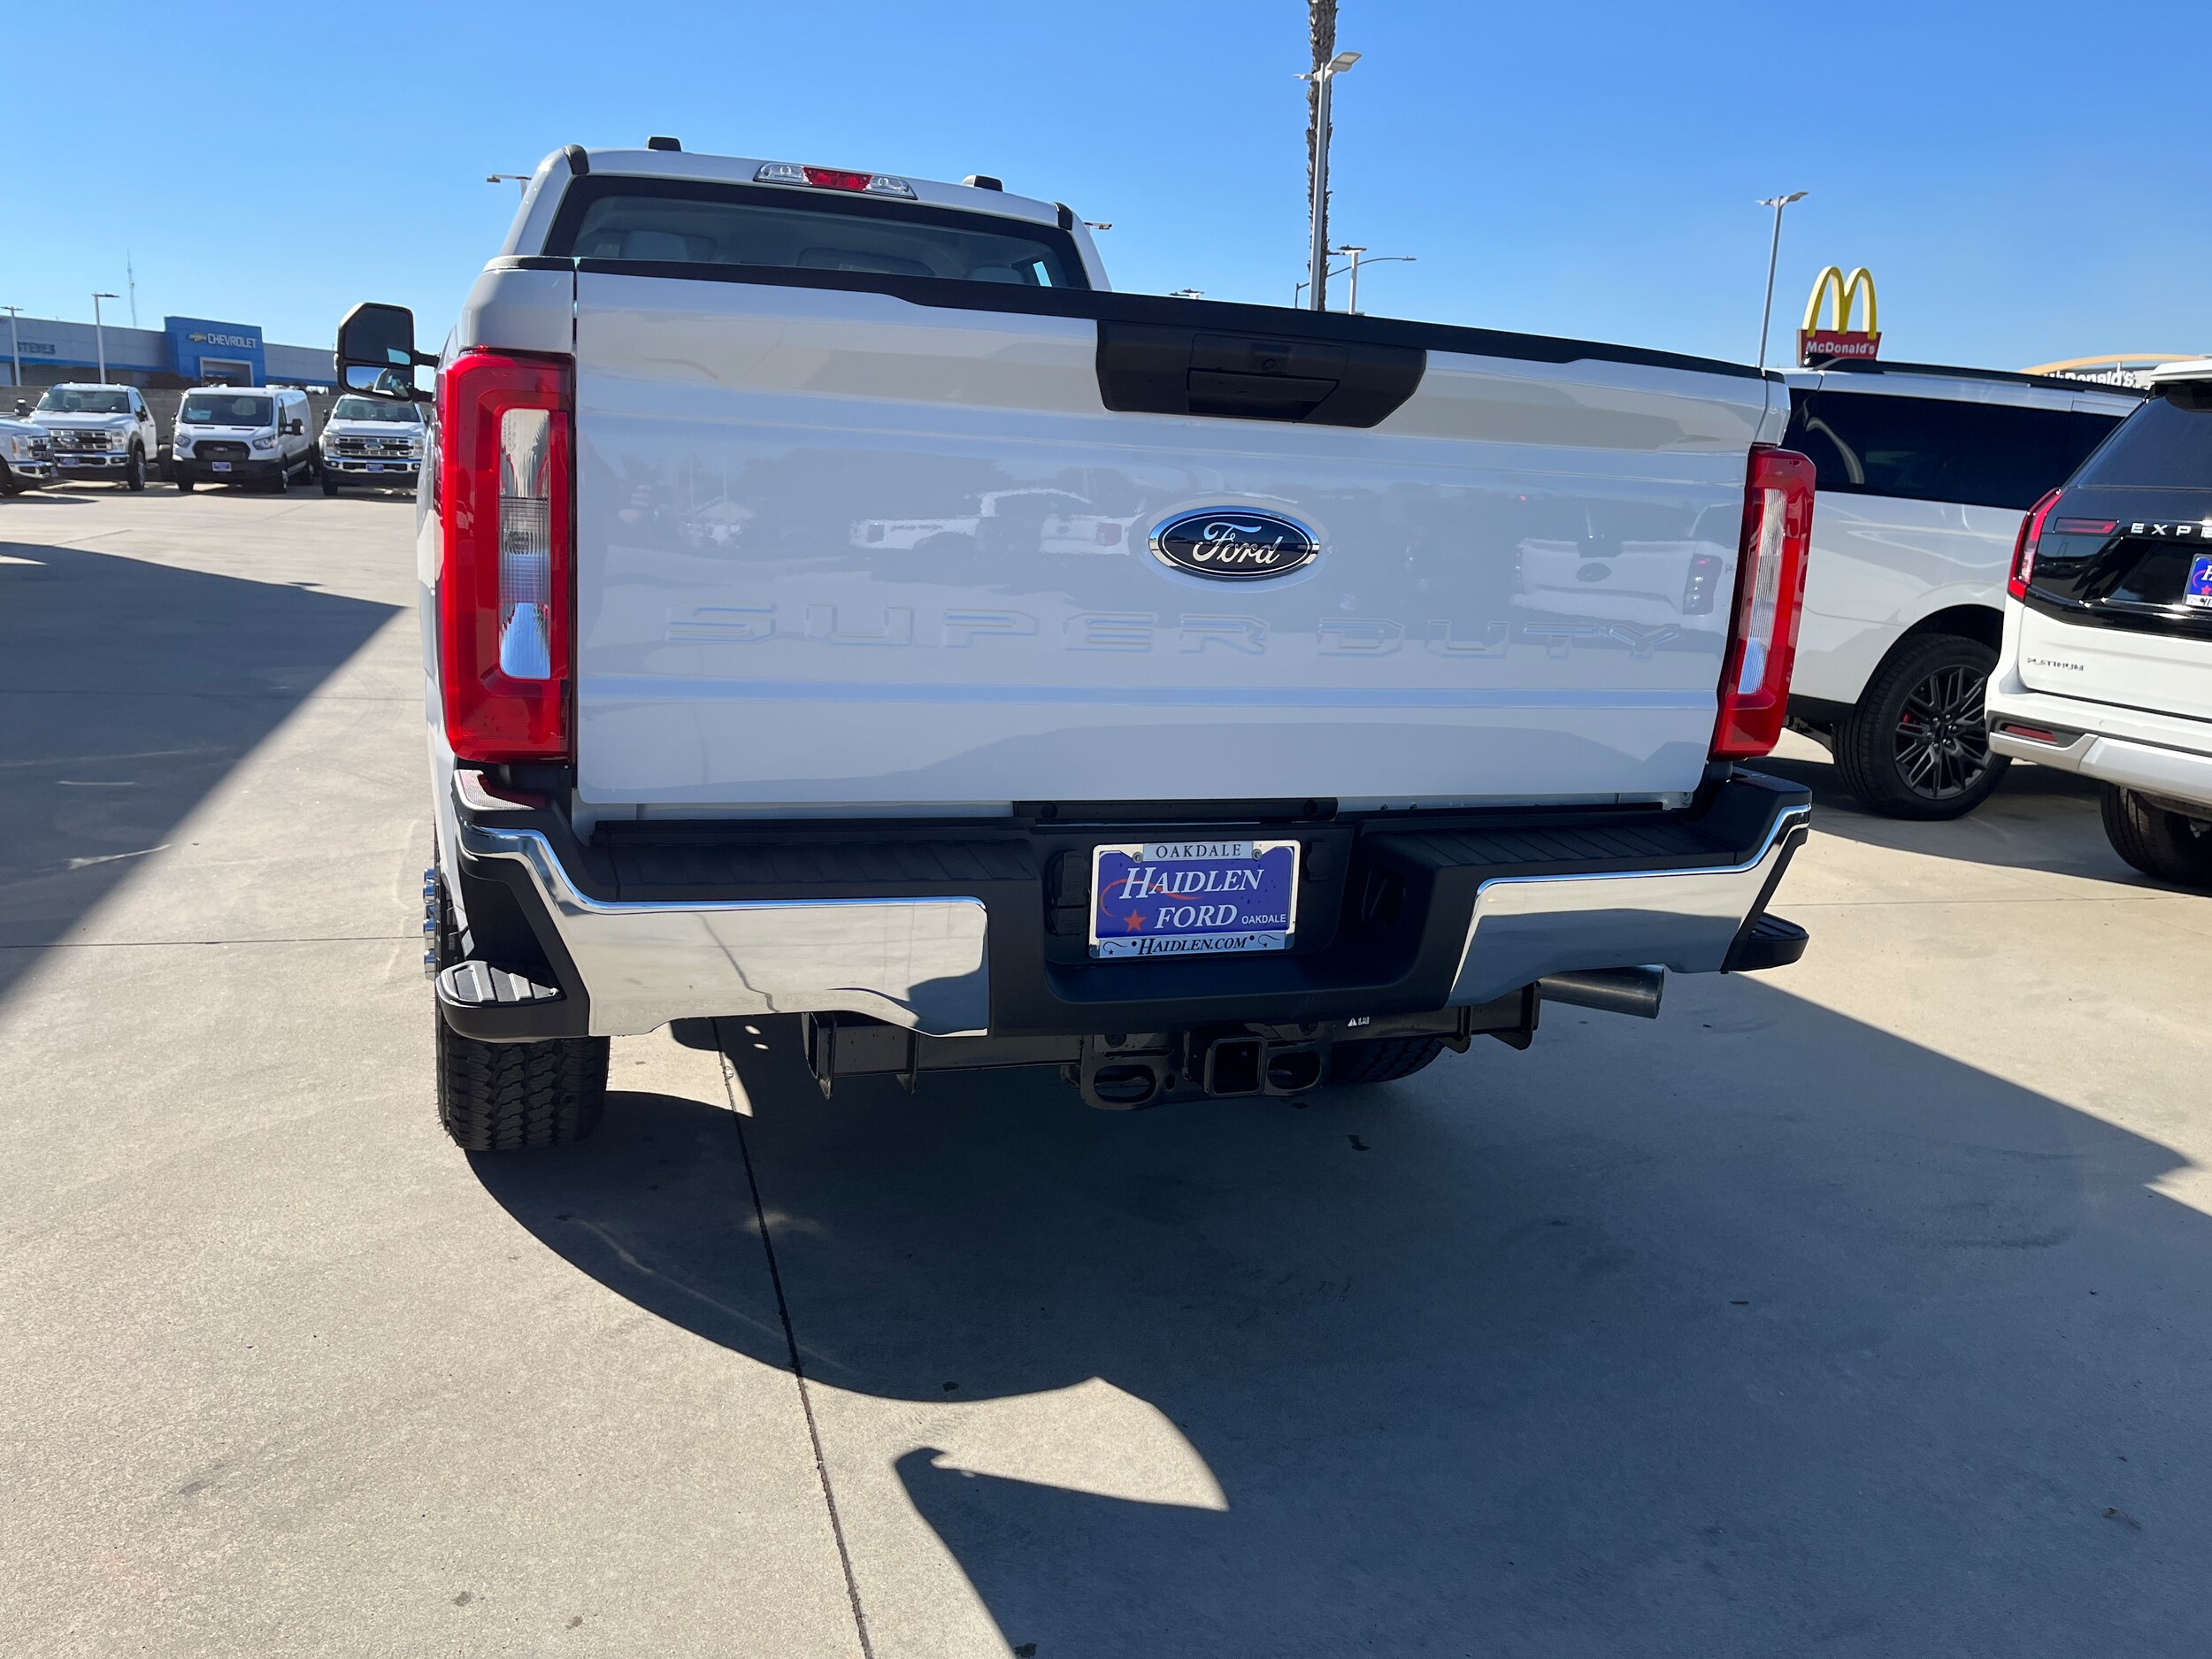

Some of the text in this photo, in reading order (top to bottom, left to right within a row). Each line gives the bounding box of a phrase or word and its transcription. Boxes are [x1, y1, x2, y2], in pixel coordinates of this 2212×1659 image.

[207, 333, 257, 349] CHEVROLET
[1806, 341, 1875, 354] McDonald's
[1192, 521, 1284, 565] Ford
[664, 601, 1681, 662] SUPER DUTY
[1156, 843, 1241, 858] OAKDALE
[1118, 866, 1265, 900] HAIDLEN
[1154, 904, 1286, 929] FORD OAKDALE
